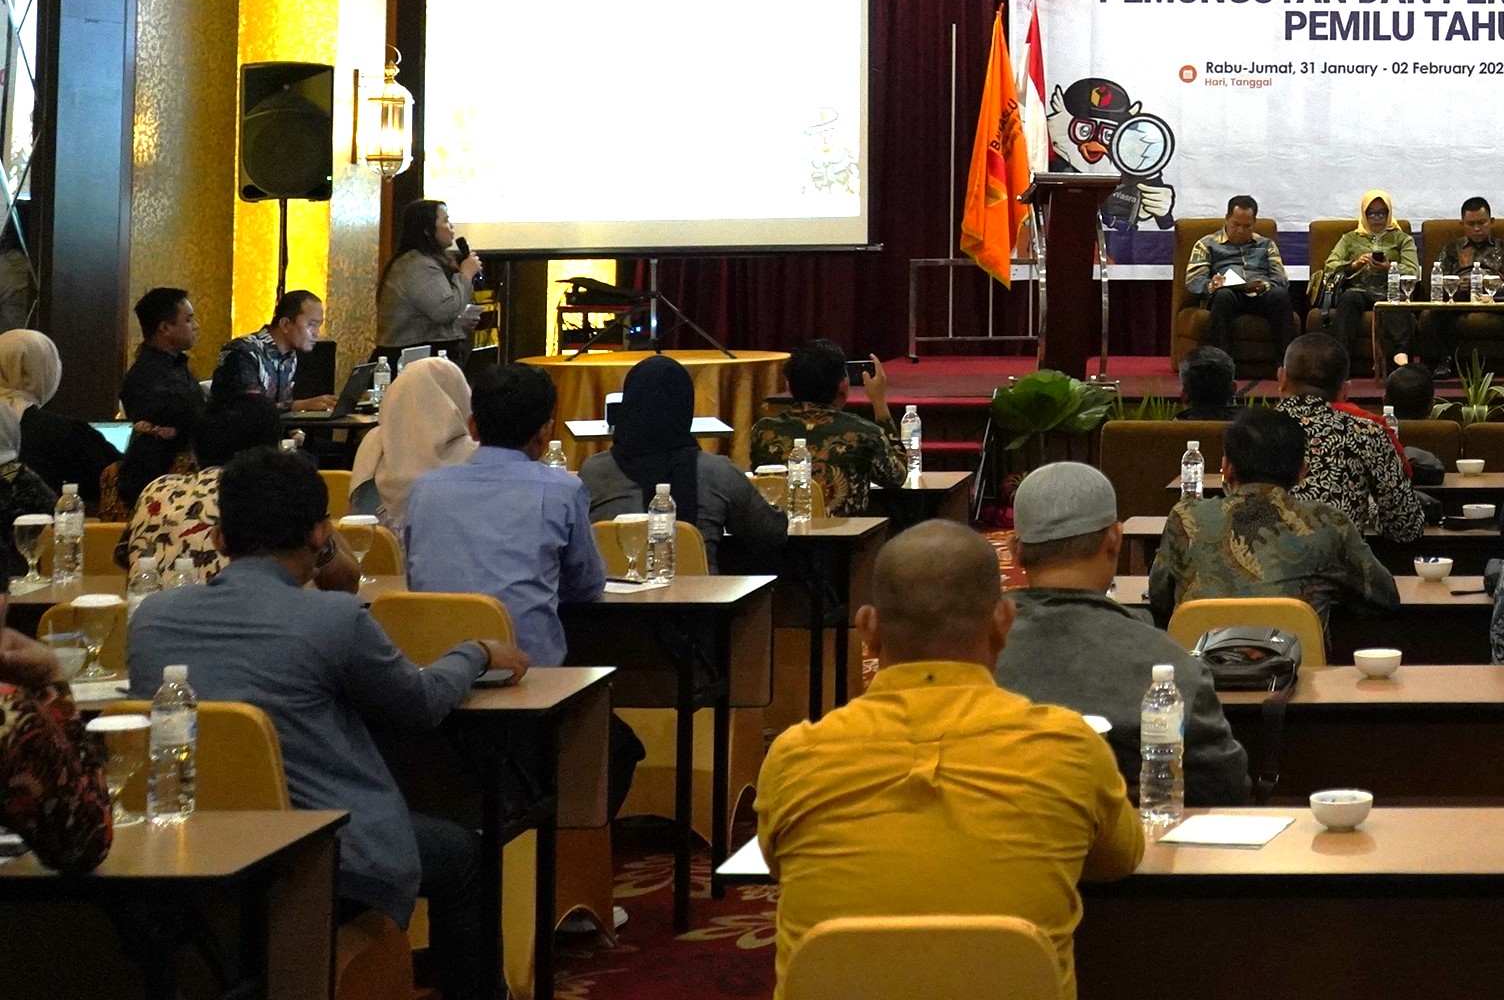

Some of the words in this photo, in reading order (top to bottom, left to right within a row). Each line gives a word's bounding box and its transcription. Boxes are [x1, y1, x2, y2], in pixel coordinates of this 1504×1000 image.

[1285, 11, 1415, 42] PEMILU
[1206, 61, 1296, 75] Rabu-Jumat,
[1300, 61, 1315, 74] 31
[1321, 61, 1378, 77] January
[1391, 62, 1409, 74] 02
[1413, 61, 1475, 77] February
[1205, 78, 1228, 87] Hari,
[1231, 78, 1273, 89] Tanggal
[990, 98, 1018, 152] BASLU
